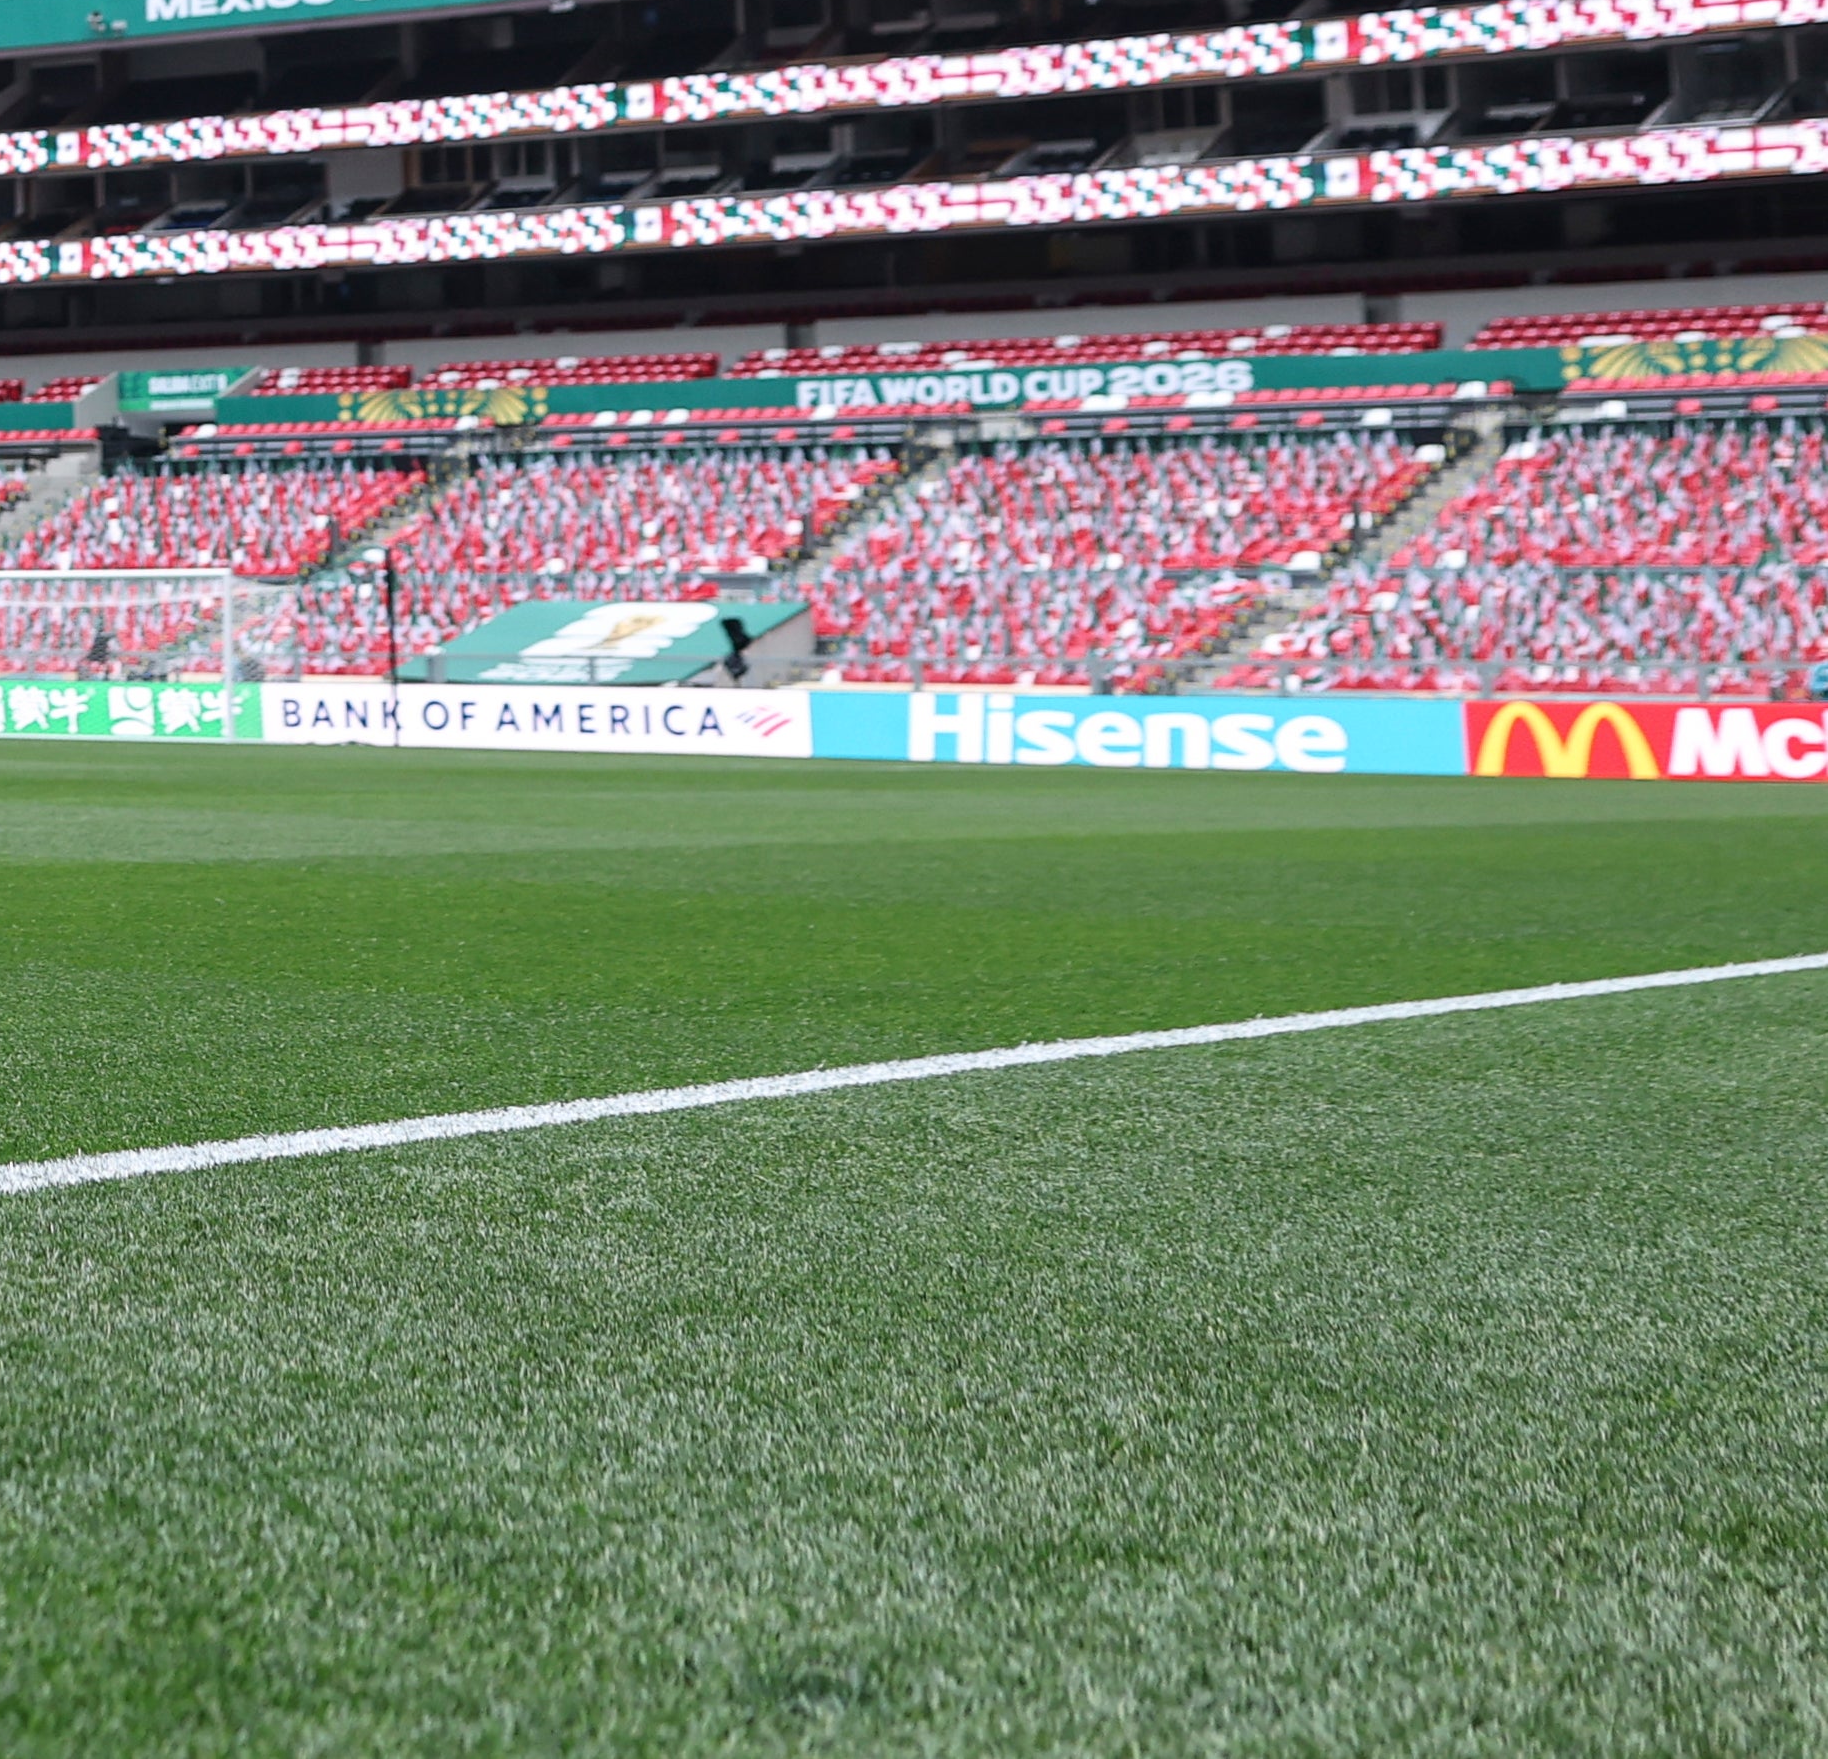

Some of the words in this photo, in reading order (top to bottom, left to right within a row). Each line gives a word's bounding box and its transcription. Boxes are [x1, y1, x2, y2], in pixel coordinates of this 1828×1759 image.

[796, 378, 879, 409] FIFA
[878, 373, 1020, 405] WORLD
[1023, 368, 1104, 401] CUP
[1107, 360, 1254, 397] 2026
[283, 699, 401, 731] BANK
[423, 700, 477, 732] OF
[495, 702, 723, 738] AMERICA
[907, 692, 1347, 773] Hisense
[1668, 707, 1828, 779] Mc
